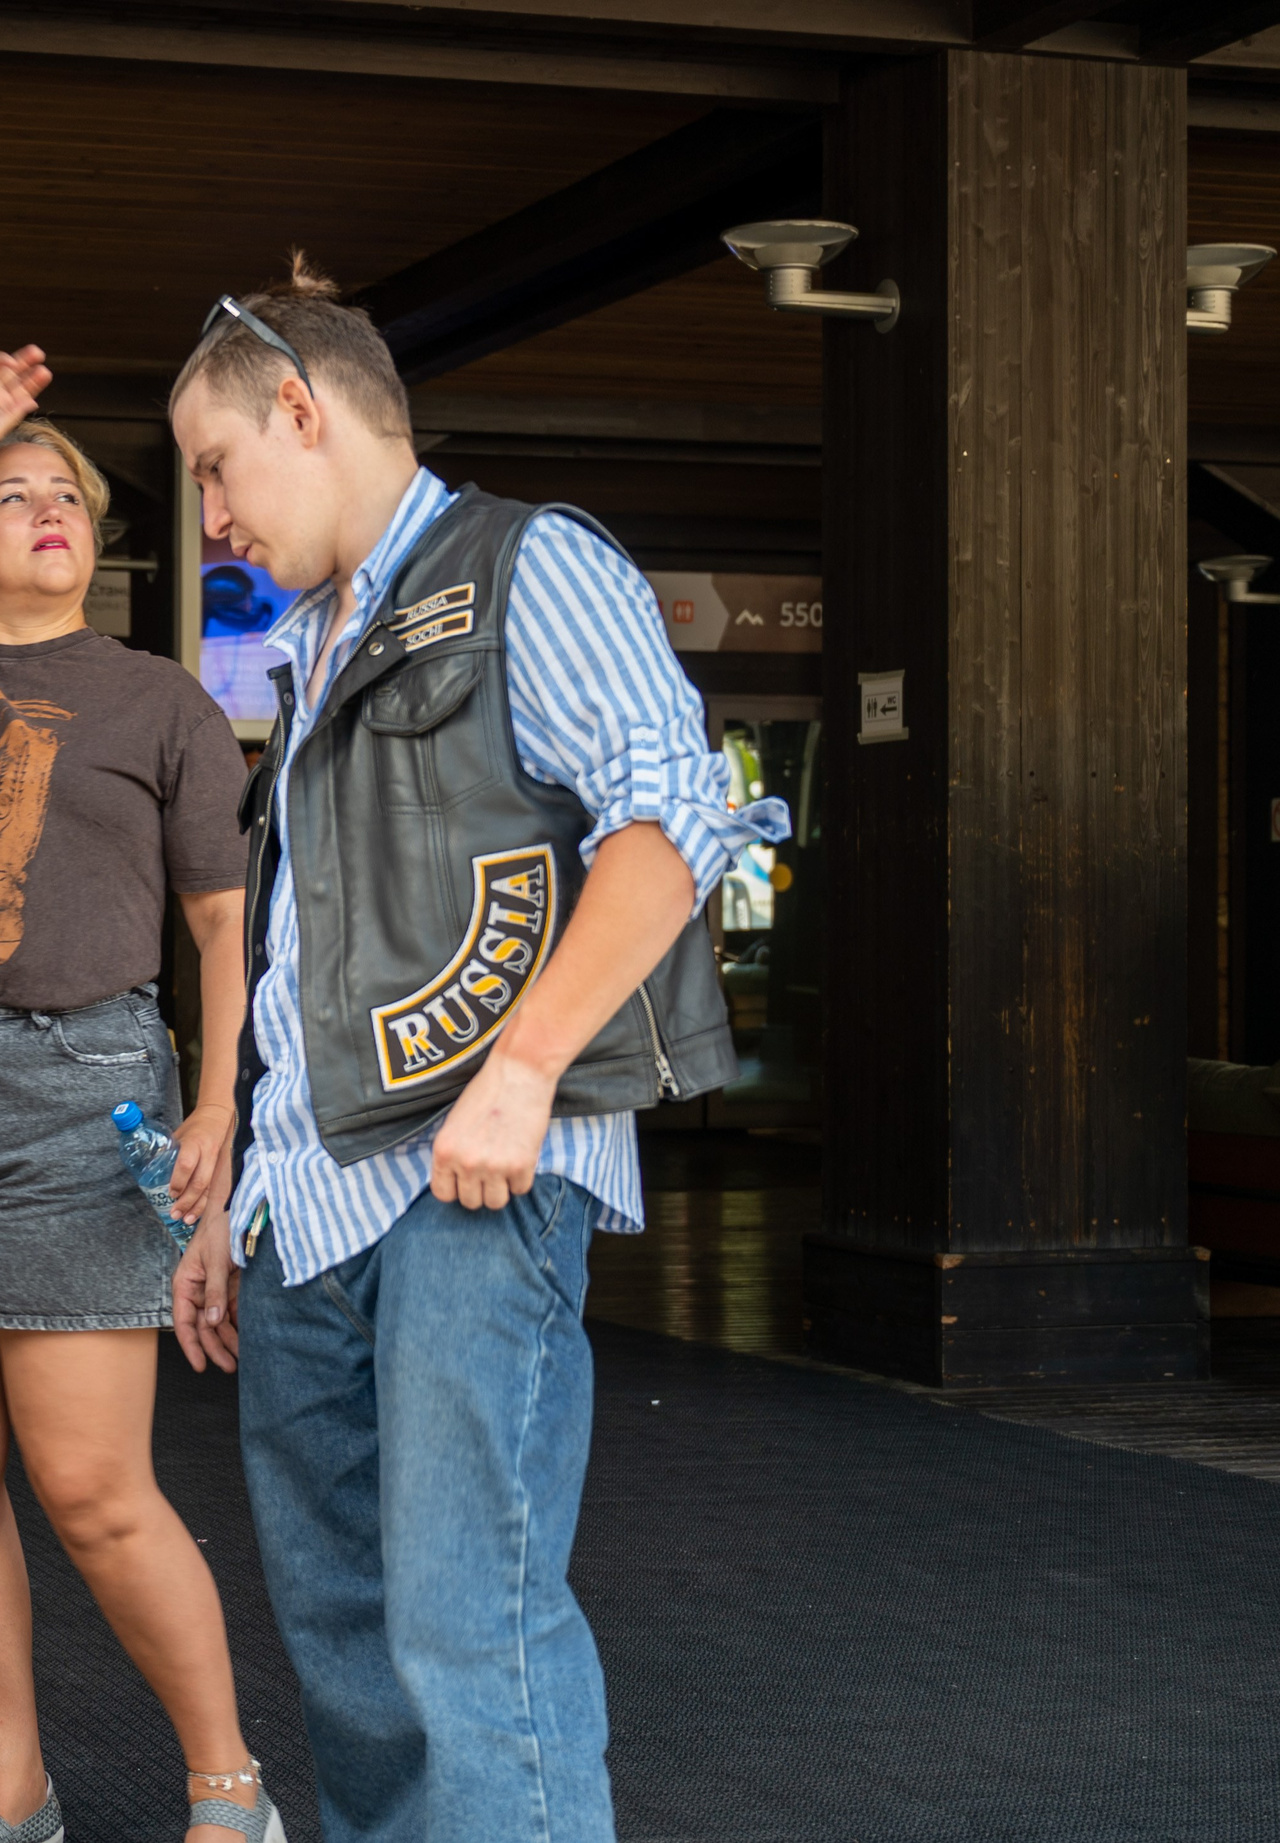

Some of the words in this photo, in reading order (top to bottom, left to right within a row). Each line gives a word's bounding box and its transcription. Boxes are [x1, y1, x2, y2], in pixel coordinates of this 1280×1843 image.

[405, 595, 449, 622] RUSSIA
[780, 601, 823, 628] 550
[406, 623, 444, 646] SOCHI
[887, 695, 897, 705] WC
[388, 863, 545, 1073] RUSSIA
